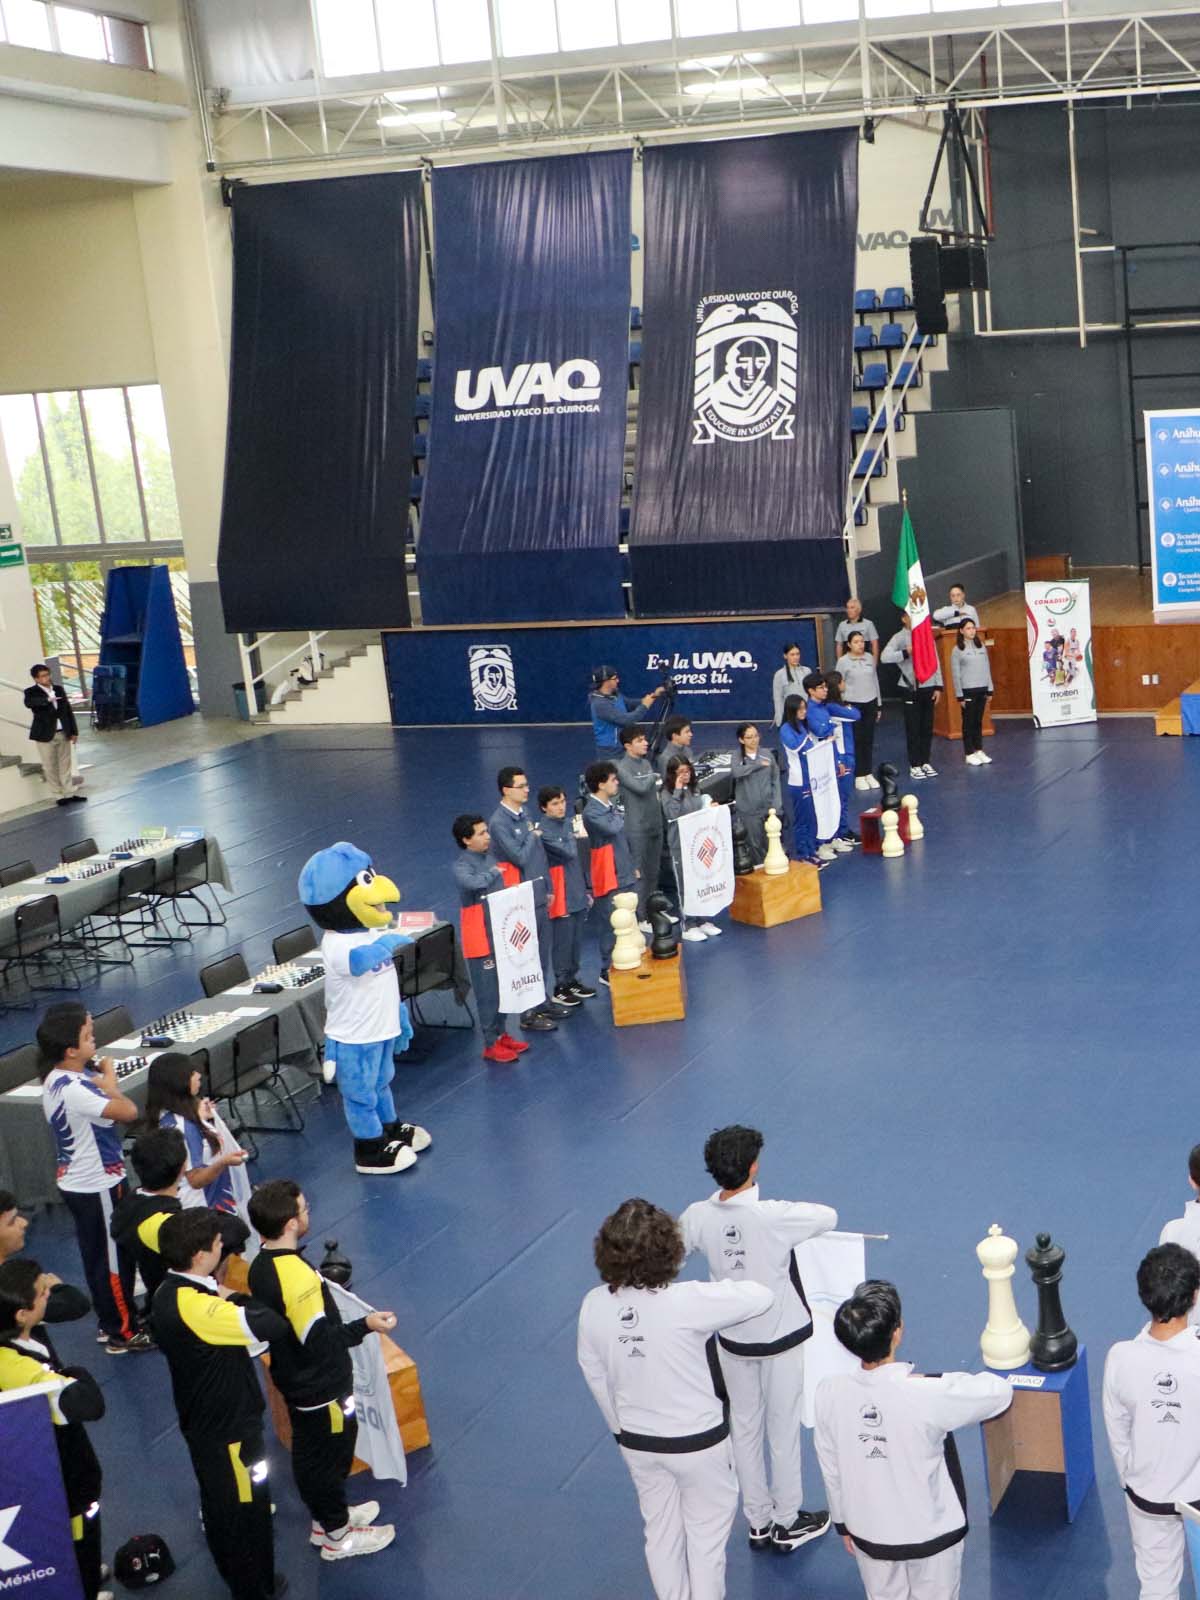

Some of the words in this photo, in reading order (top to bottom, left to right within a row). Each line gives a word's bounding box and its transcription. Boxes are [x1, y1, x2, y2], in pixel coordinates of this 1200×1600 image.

[857, 230, 909, 251] VAQ
[696, 293, 735, 323] UNIVERSIDAD
[735, 292, 761, 302] VASCO
[761, 291, 772, 300] DE
[773, 290, 799, 316] QUIROGA
[454, 359, 602, 411] UVAQ
[454, 409, 511, 422] UNIVERSIDAD
[512, 406, 541, 417] VASCO
[543, 405, 555, 415] DE
[556, 404, 600, 415] QUIROGA
[705, 409, 737, 436] EDUCERE
[737, 427, 747, 436] IN
[748, 405, 784, 434] VERITATE
[673, 653, 690, 670] la
[0, 1566, 56, 1590] México
